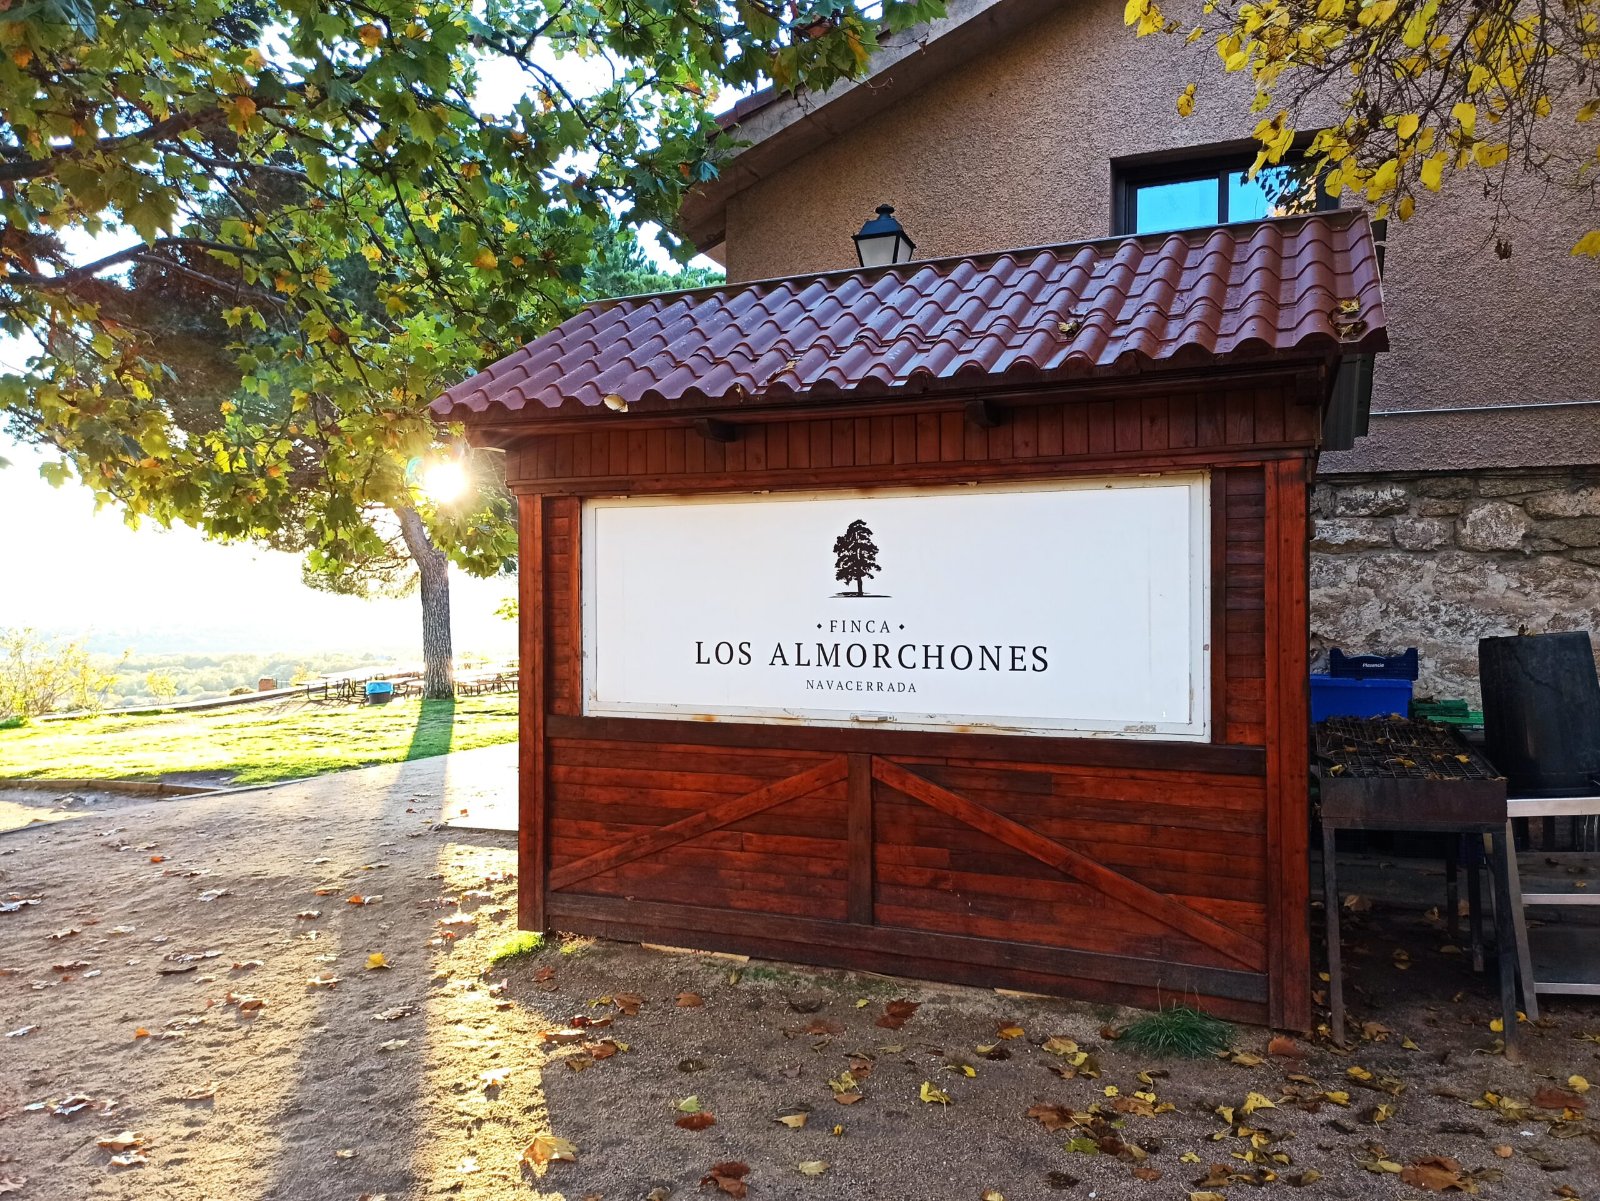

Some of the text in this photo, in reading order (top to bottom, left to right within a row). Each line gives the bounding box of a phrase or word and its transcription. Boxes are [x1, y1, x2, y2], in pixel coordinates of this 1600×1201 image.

[829, 619, 891, 634] FINCA
[695, 641, 1048, 673] LOS ALMORCHONES
[806, 679, 917, 693] NAVACERRADA
